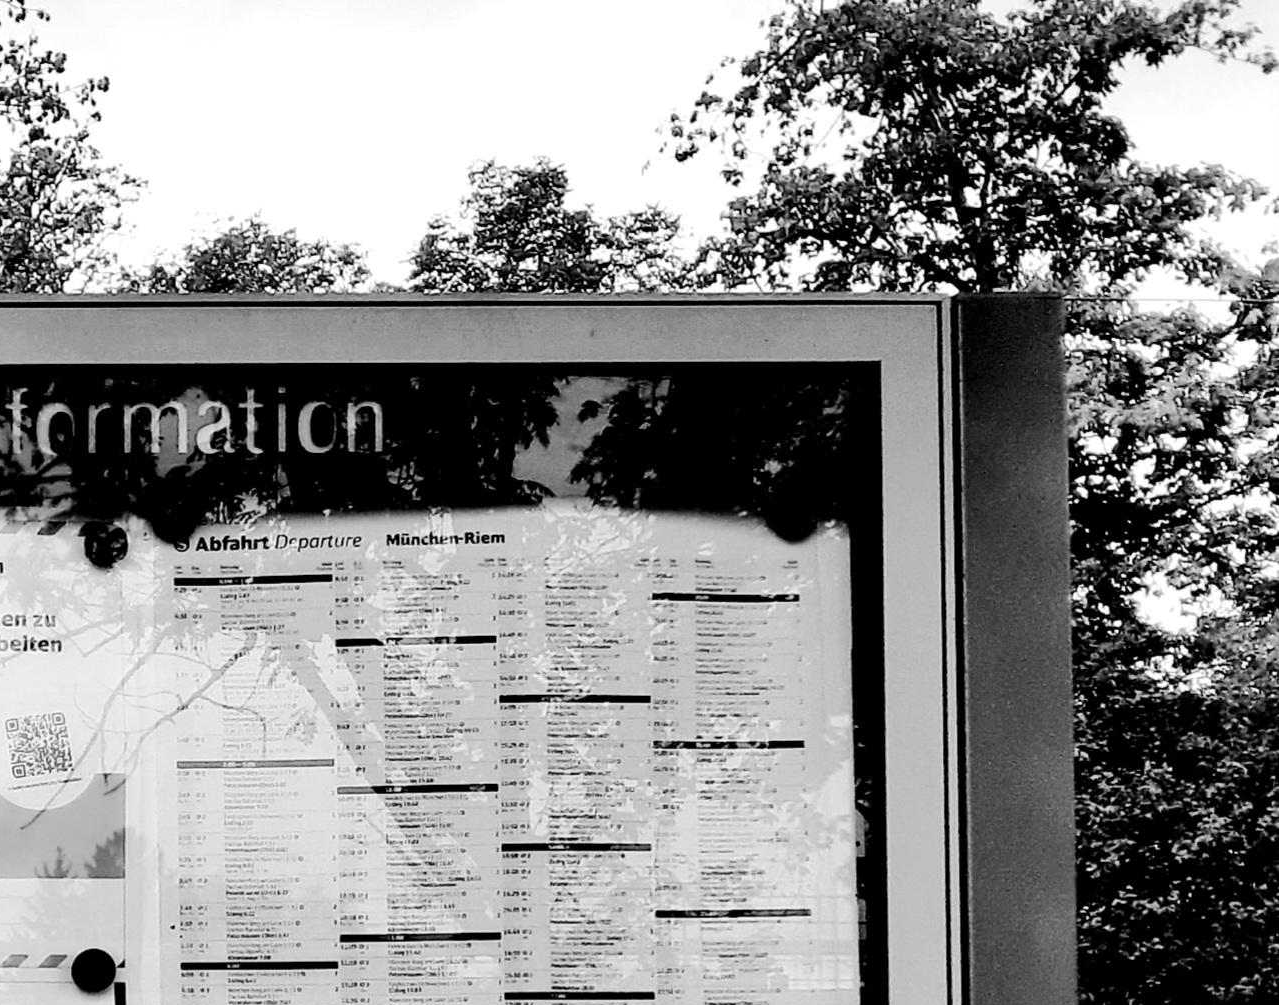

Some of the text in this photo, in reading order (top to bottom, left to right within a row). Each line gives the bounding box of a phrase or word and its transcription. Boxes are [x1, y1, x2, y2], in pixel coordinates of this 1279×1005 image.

[195, 532, 505, 552] Abfahrt Departure München-Riem
[33, 613, 57, 628] zu
